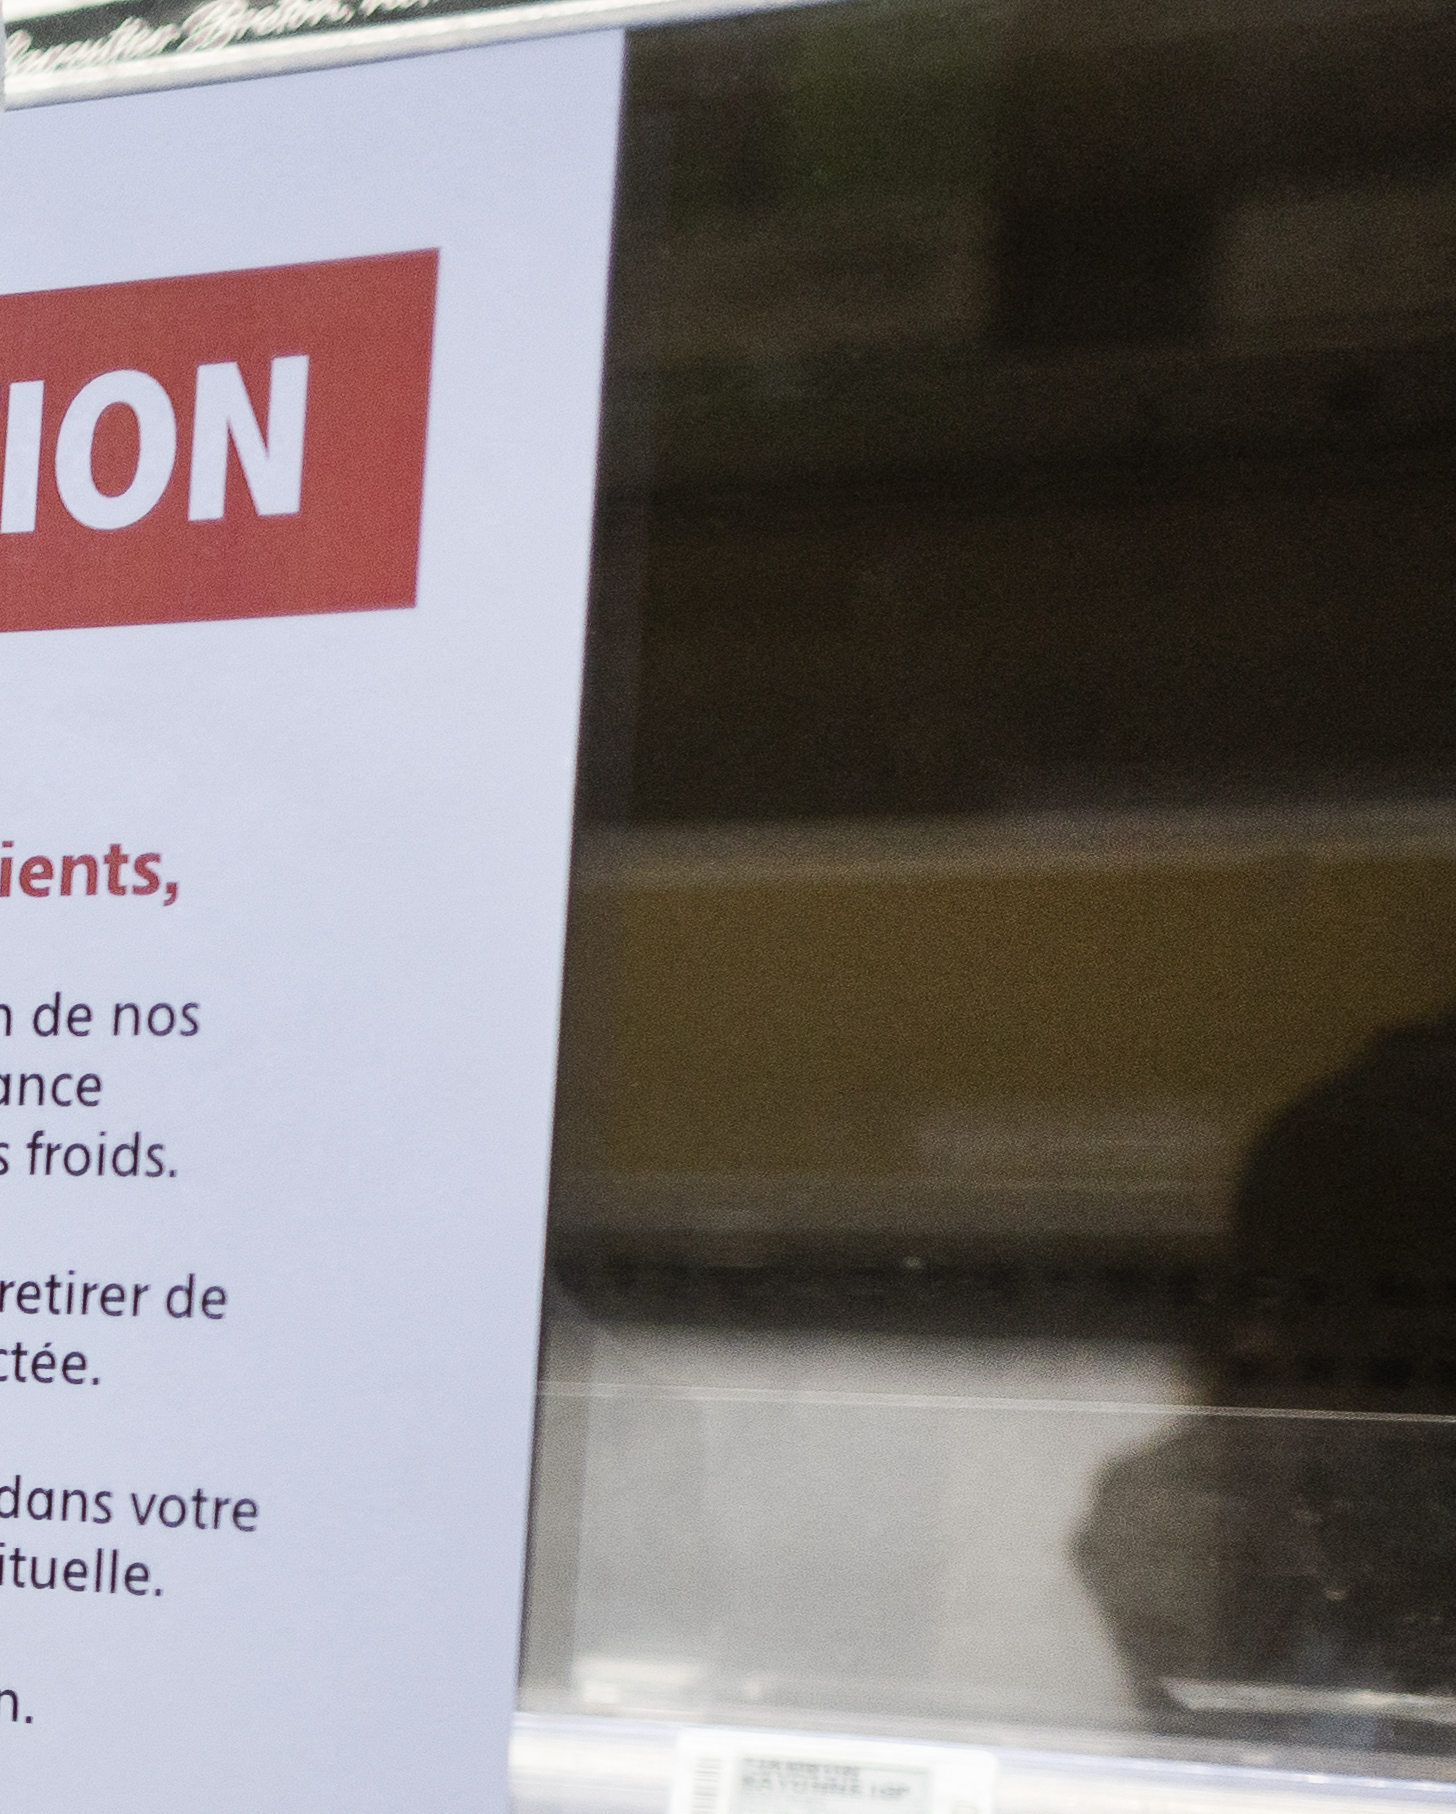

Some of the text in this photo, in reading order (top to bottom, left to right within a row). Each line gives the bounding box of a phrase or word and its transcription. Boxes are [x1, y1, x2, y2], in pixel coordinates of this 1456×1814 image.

[32, 991, 93, 1037] de
[113, 1002, 200, 1037] nos
[26, 1130, 176, 1178] froids.
[165, 1273, 227, 1320] de
[130, 1488, 258, 1532] votre
